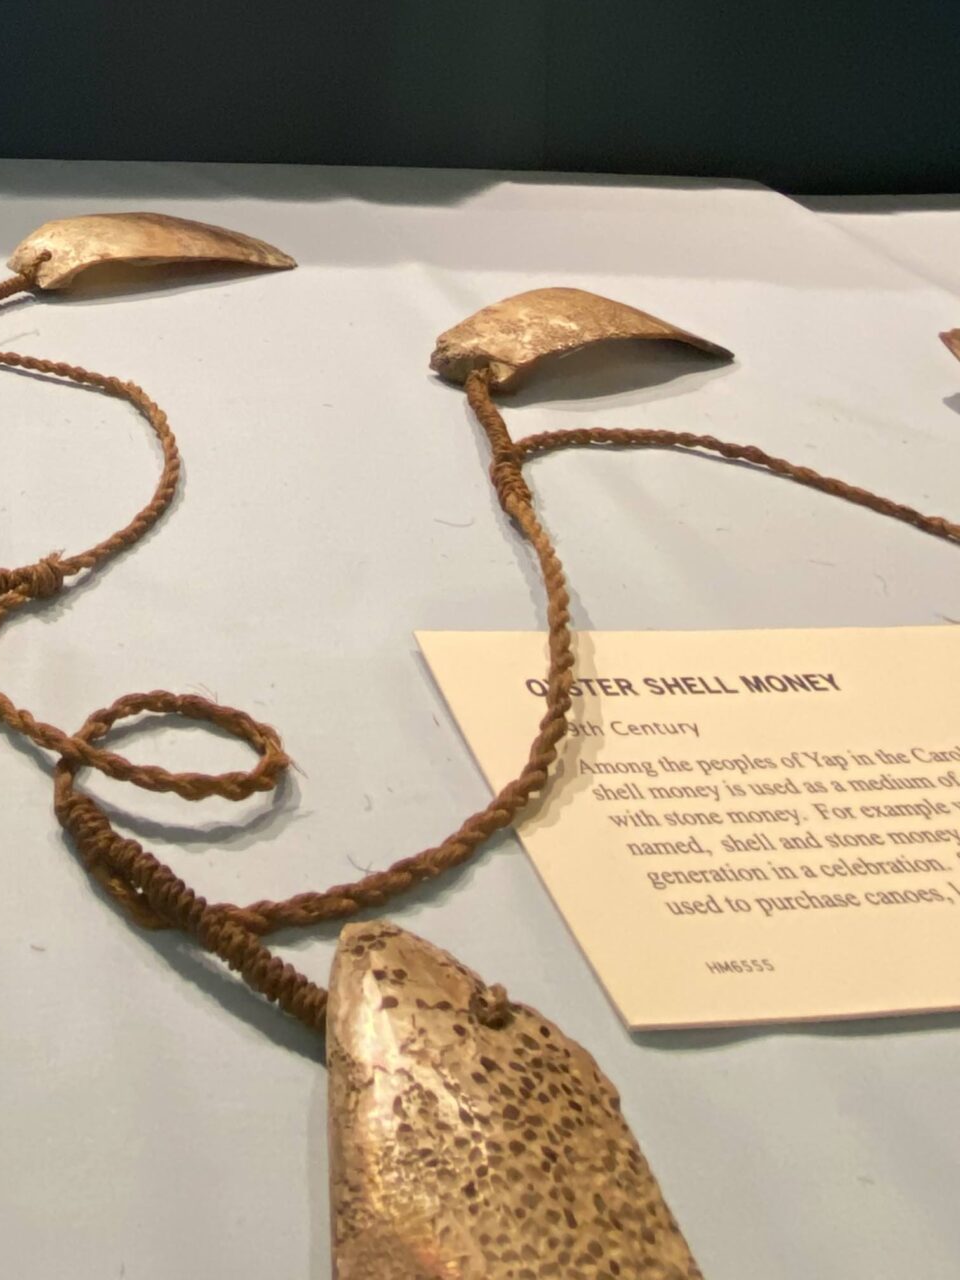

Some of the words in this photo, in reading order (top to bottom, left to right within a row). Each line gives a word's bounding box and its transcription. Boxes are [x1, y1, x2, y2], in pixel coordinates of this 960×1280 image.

[525, 677, 639, 697] OSTER
[642, 676, 739, 695] SHELL
[740, 671, 841, 694] MONEY
[568, 721, 605, 737] 9th
[610, 720, 700, 737] Century
[579, 758, 659, 777] Among
[657, 755, 694, 772] the
[696, 753, 778, 776] peoples
[780, 752, 805, 769] of
[801, 751, 849, 770] Yap
[847, 749, 876, 766] in
[874, 748, 911, 765] the
[591, 782, 646, 801] shell
[647, 785, 720, 802] money
[722, 779, 747, 797] is
[748, 777, 802, 796] used
[803, 781, 828, 794] as
[830, 780, 847, 793] a
[847, 773, 937, 792] medium
[608, 809, 661, 828] with
[663, 810, 724, 827] stone
[725, 808, 808, 826] money.
[811, 802, 858, 821] For
[859, 798, 952, 820] example
[626, 835, 713, 857] named,
[720, 832, 778, 853] shell
[779, 830, 823, 851] and
[824, 832, 886, 848] stone
[646, 862, 771, 891] generation
[766, 860, 800, 881] in
[799, 864, 819, 879] a
[818, 854, 953, 878] celebration.
[665, 893, 725, 916] used
[724, 895, 753, 913] to
[754, 889, 862, 918] purchase
[863, 887, 956, 906] canoes,
[704, 958, 776, 974] HM6555
